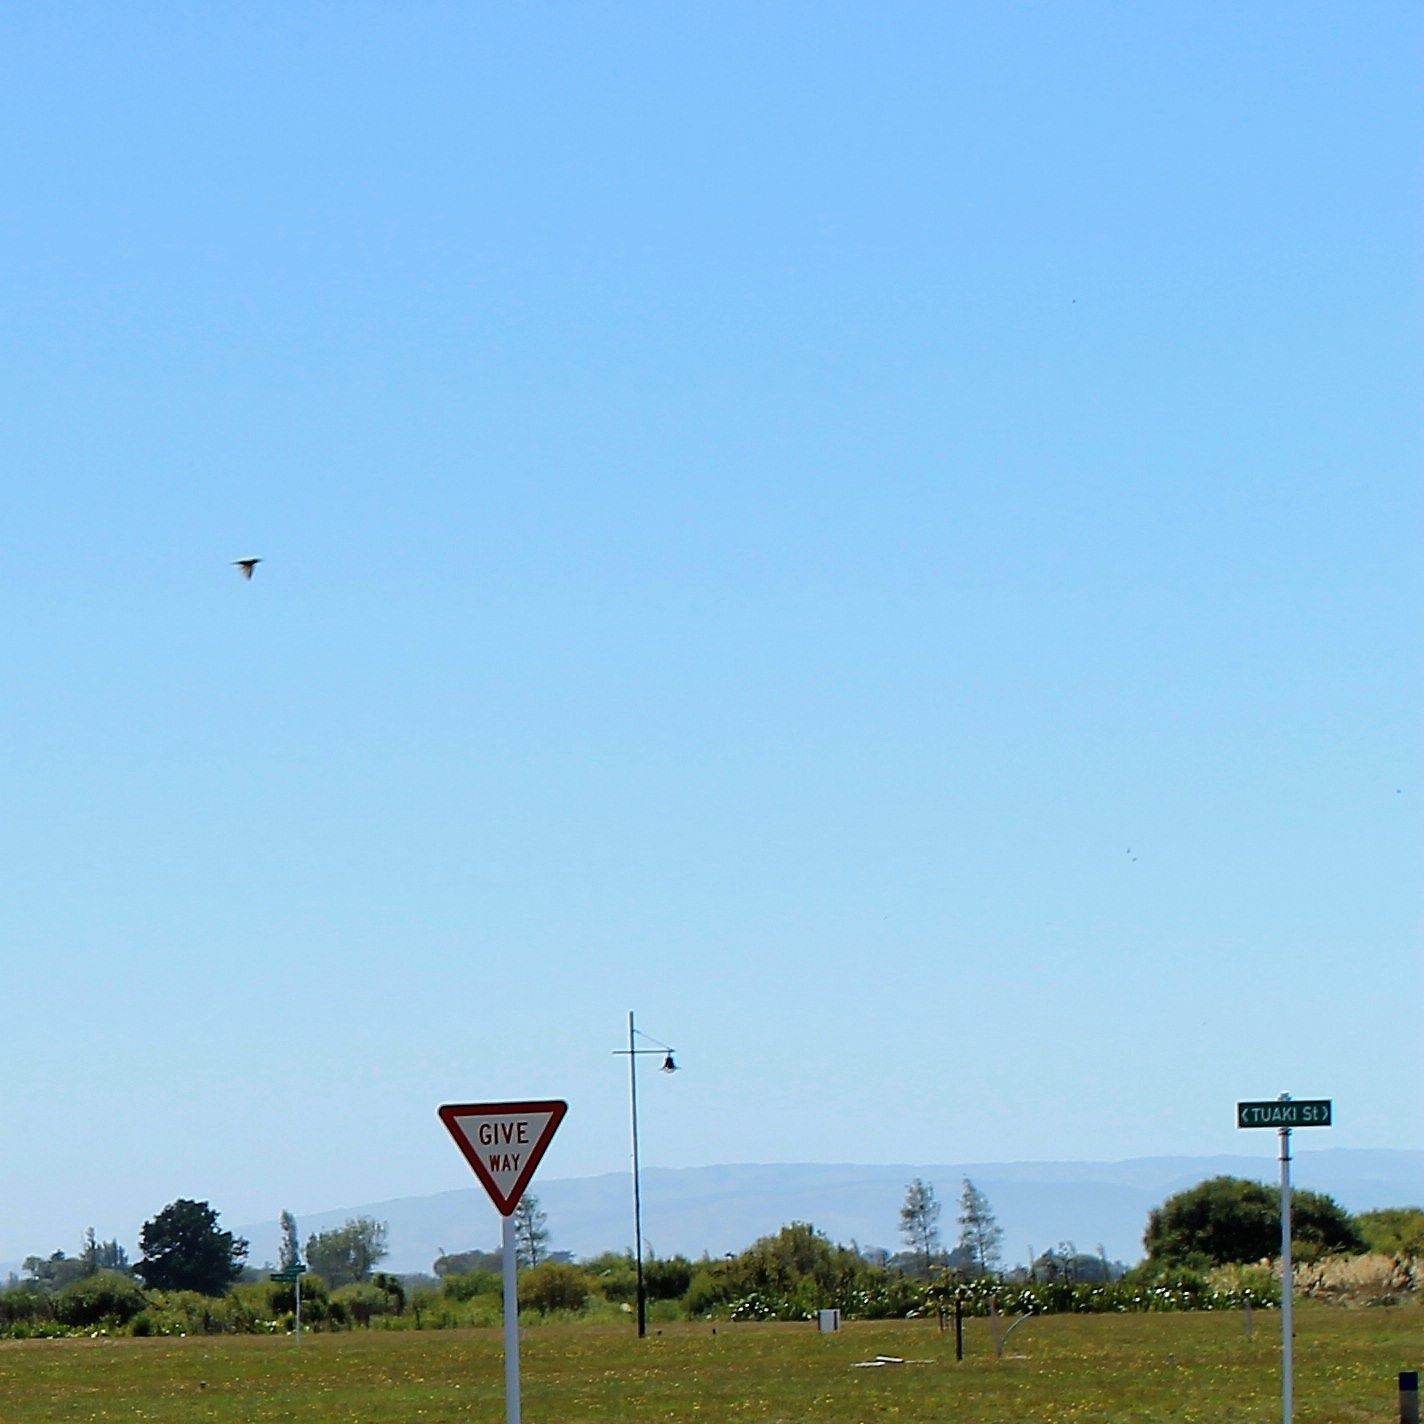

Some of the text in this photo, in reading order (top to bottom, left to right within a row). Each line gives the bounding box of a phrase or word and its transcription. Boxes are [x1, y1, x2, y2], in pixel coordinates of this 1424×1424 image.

[1251, 1106, 1318, 1122] TUAKI St
[479, 1122, 529, 1145] GIVE
[489, 1154, 520, 1172] WAY
